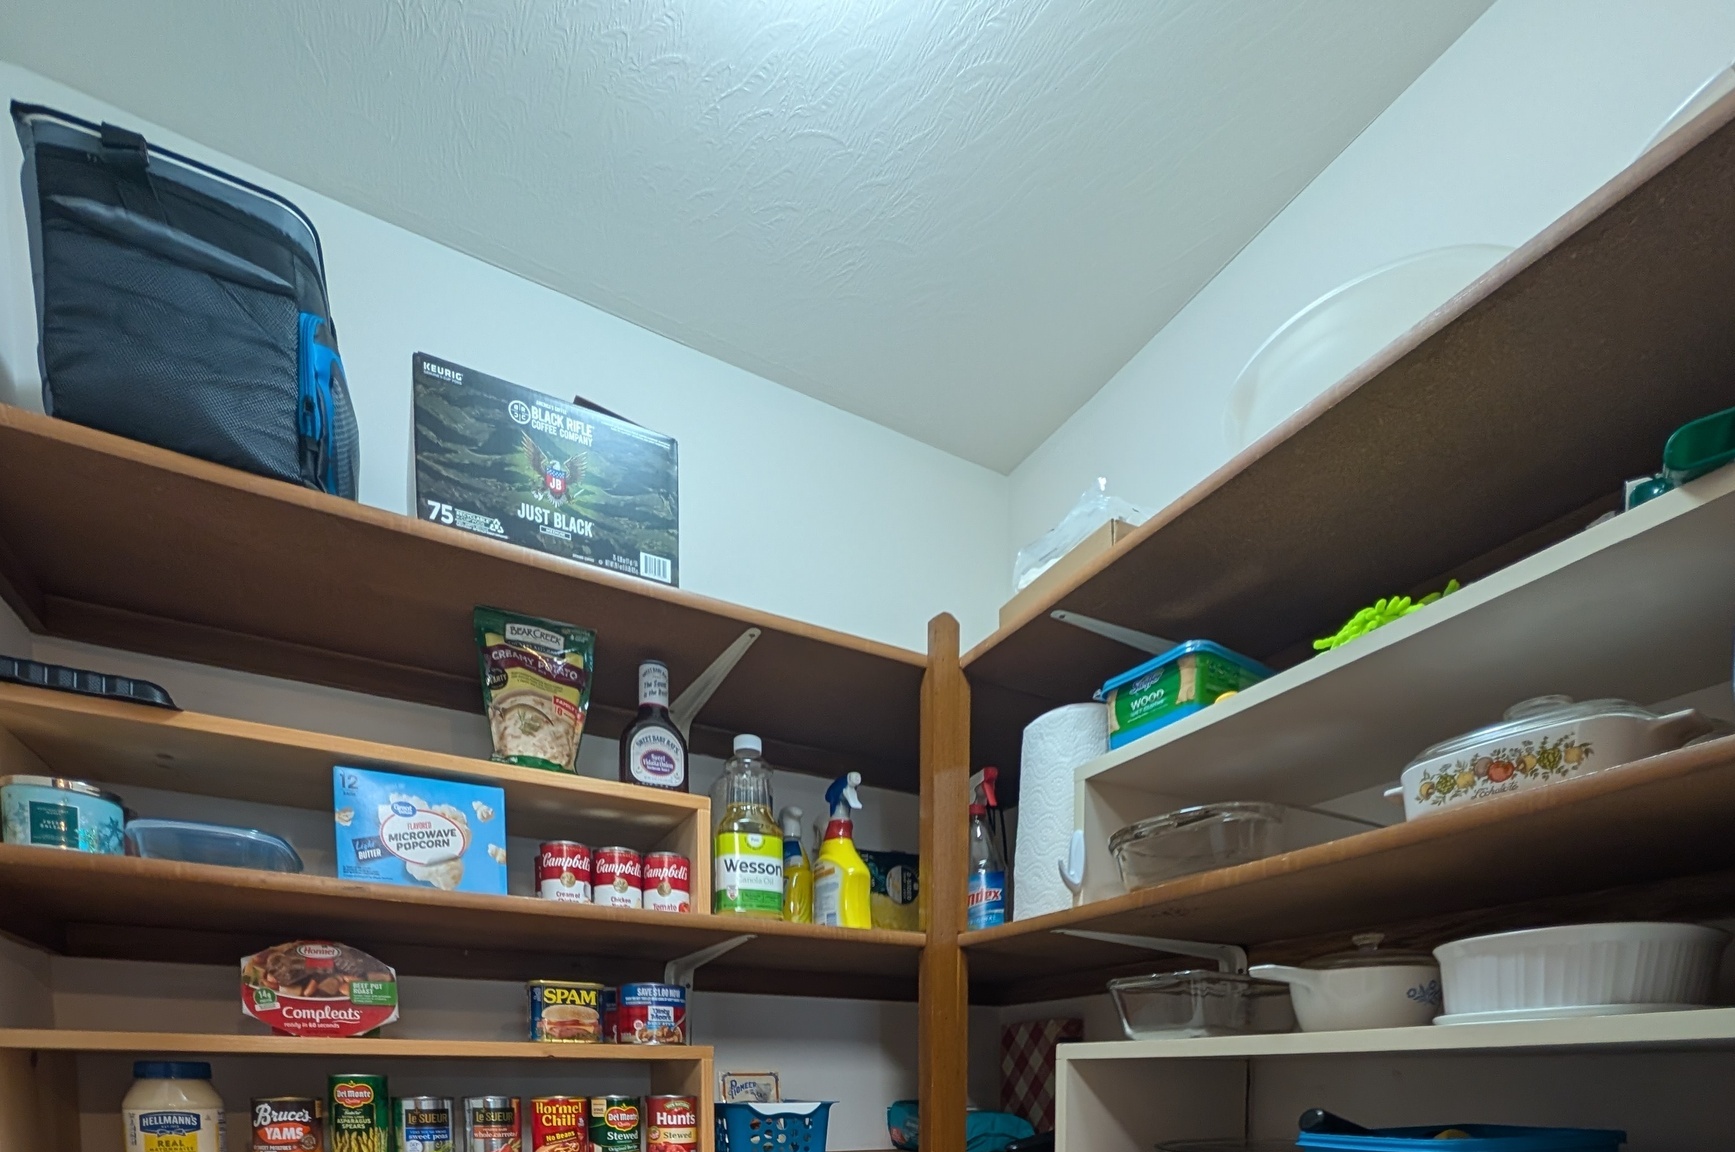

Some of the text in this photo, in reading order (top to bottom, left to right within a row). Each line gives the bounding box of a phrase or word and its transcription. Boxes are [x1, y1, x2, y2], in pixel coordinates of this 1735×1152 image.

[423, 362, 463, 382] KEURIG
[531, 405, 563, 428] BLACK
[567, 416, 594, 437] RIFLE
[531, 420, 558, 436] COFFEE
[559, 427, 594, 447] COMPANY
[549, 477, 562, 490] JB
[428, 500, 454, 524] 75
[517, 502, 593, 538] JUST BLACK
[491, 650, 534, 667] CREAMY
[1130, 688, 1165, 711] WOOD
[340, 769, 358, 789] 12
[407, 821, 432, 830] FLAVORED
[388, 829, 457, 842] MICROWAVE
[396, 839, 450, 851] POPCORN
[358, 848, 382, 860] BUTTER
[542, 852, 590, 872] Campbell's
[596, 858, 641, 877] Campbell's
[724, 858, 783, 877] Wesson
[643, 863, 688, 881] Campbell's
[556, 891, 574, 899] Cream
[610, 896, 631, 904] Chicken
[967, 888, 1001, 906] ndex
[652, 903, 678, 912] Tomato
[543, 988, 597, 1006] SPAM
[637, 987, 653, 998] SAVE
[652, 987, 669, 998] $1.00
[282, 1005, 361, 1022] Compleats
[336, 1090, 371, 1098] Del Monte
[536, 1102, 582, 1114] Hormel
[142, 1114, 197, 1127] HELLMANN'S
[253, 1103, 312, 1128] Bruce's
[408, 1112, 447, 1125] Le SUEUR
[475, 1111, 513, 1123] Le SUEUR
[542, 1114, 576, 1127] Chili
[608, 1113, 619, 1121] Del
[656, 1111, 695, 1125] Hunt's
[265, 1127, 304, 1140] YAMS
[546, 1130, 575, 1142] No Beans
[607, 1130, 638, 1141] Stewed
[663, 1131, 692, 1139] Stewed
[157, 1140, 185, 1148] REAL
